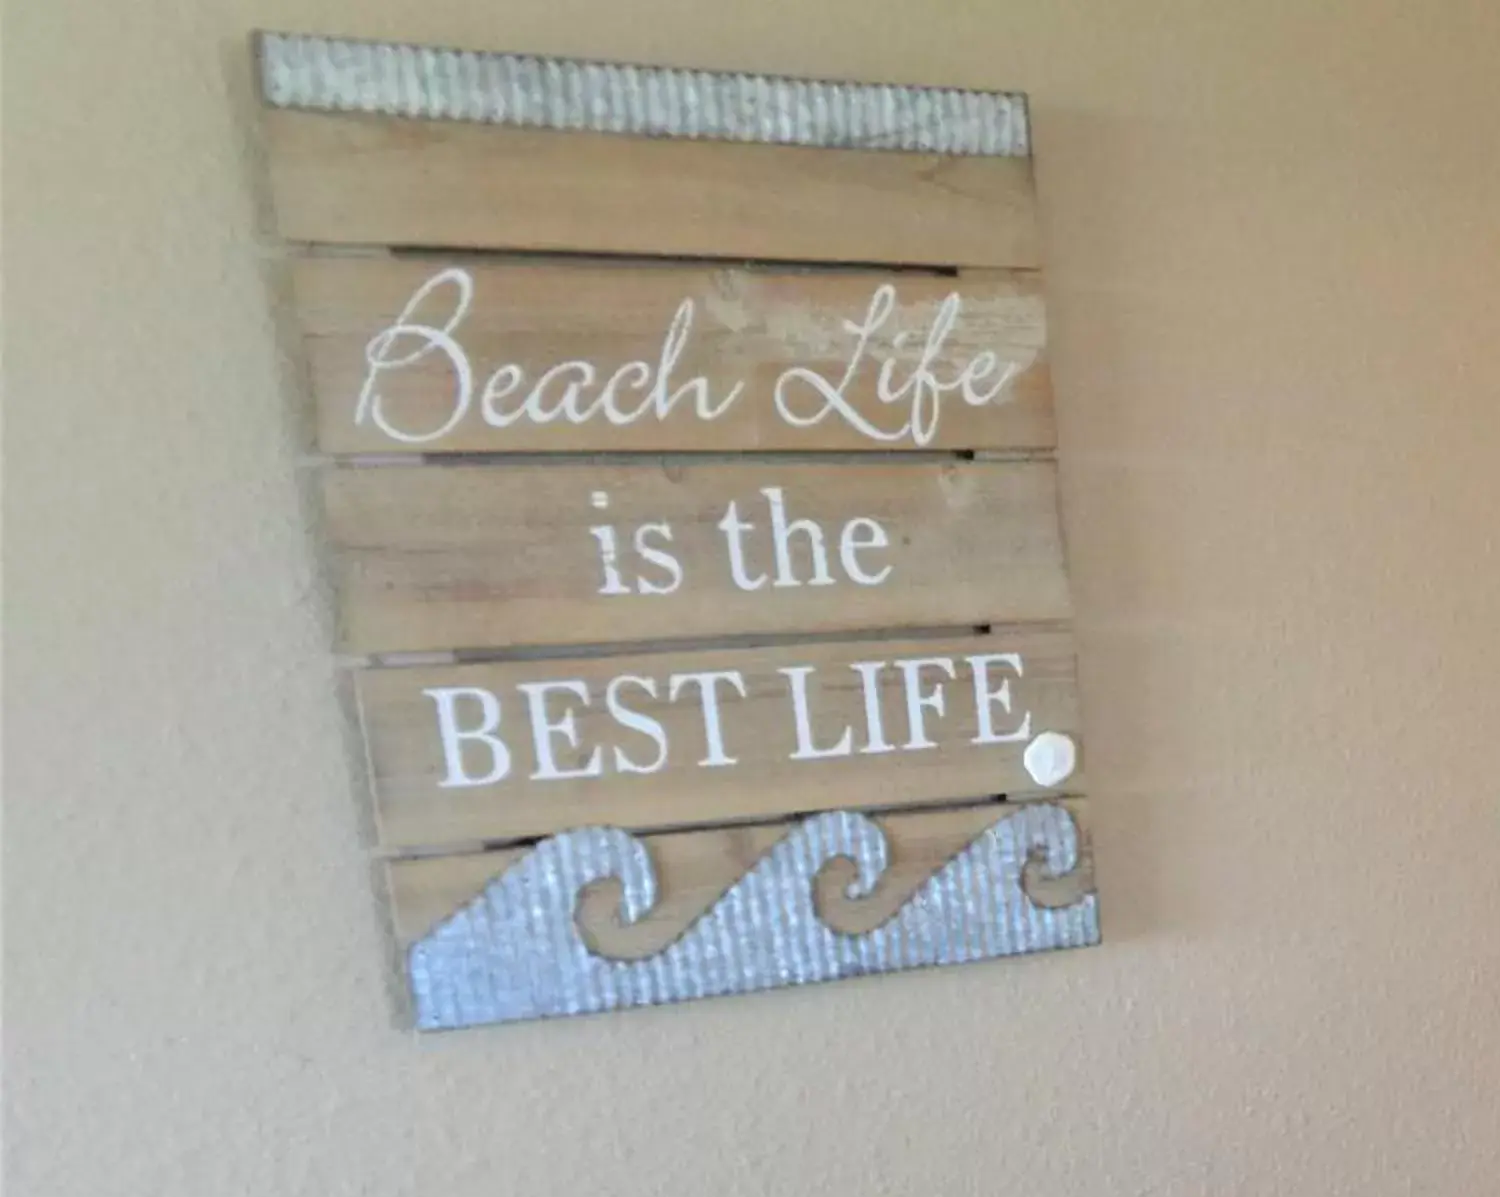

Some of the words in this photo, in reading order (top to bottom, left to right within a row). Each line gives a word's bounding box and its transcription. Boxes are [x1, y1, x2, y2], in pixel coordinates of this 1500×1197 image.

[354, 267, 744, 443] Beach
[773, 283, 1017, 446] Life
[590, 490, 682, 596] is
[719, 486, 893, 591] the
[422, 670, 746, 788] BEST
[778, 652, 1032, 762] LIFE
